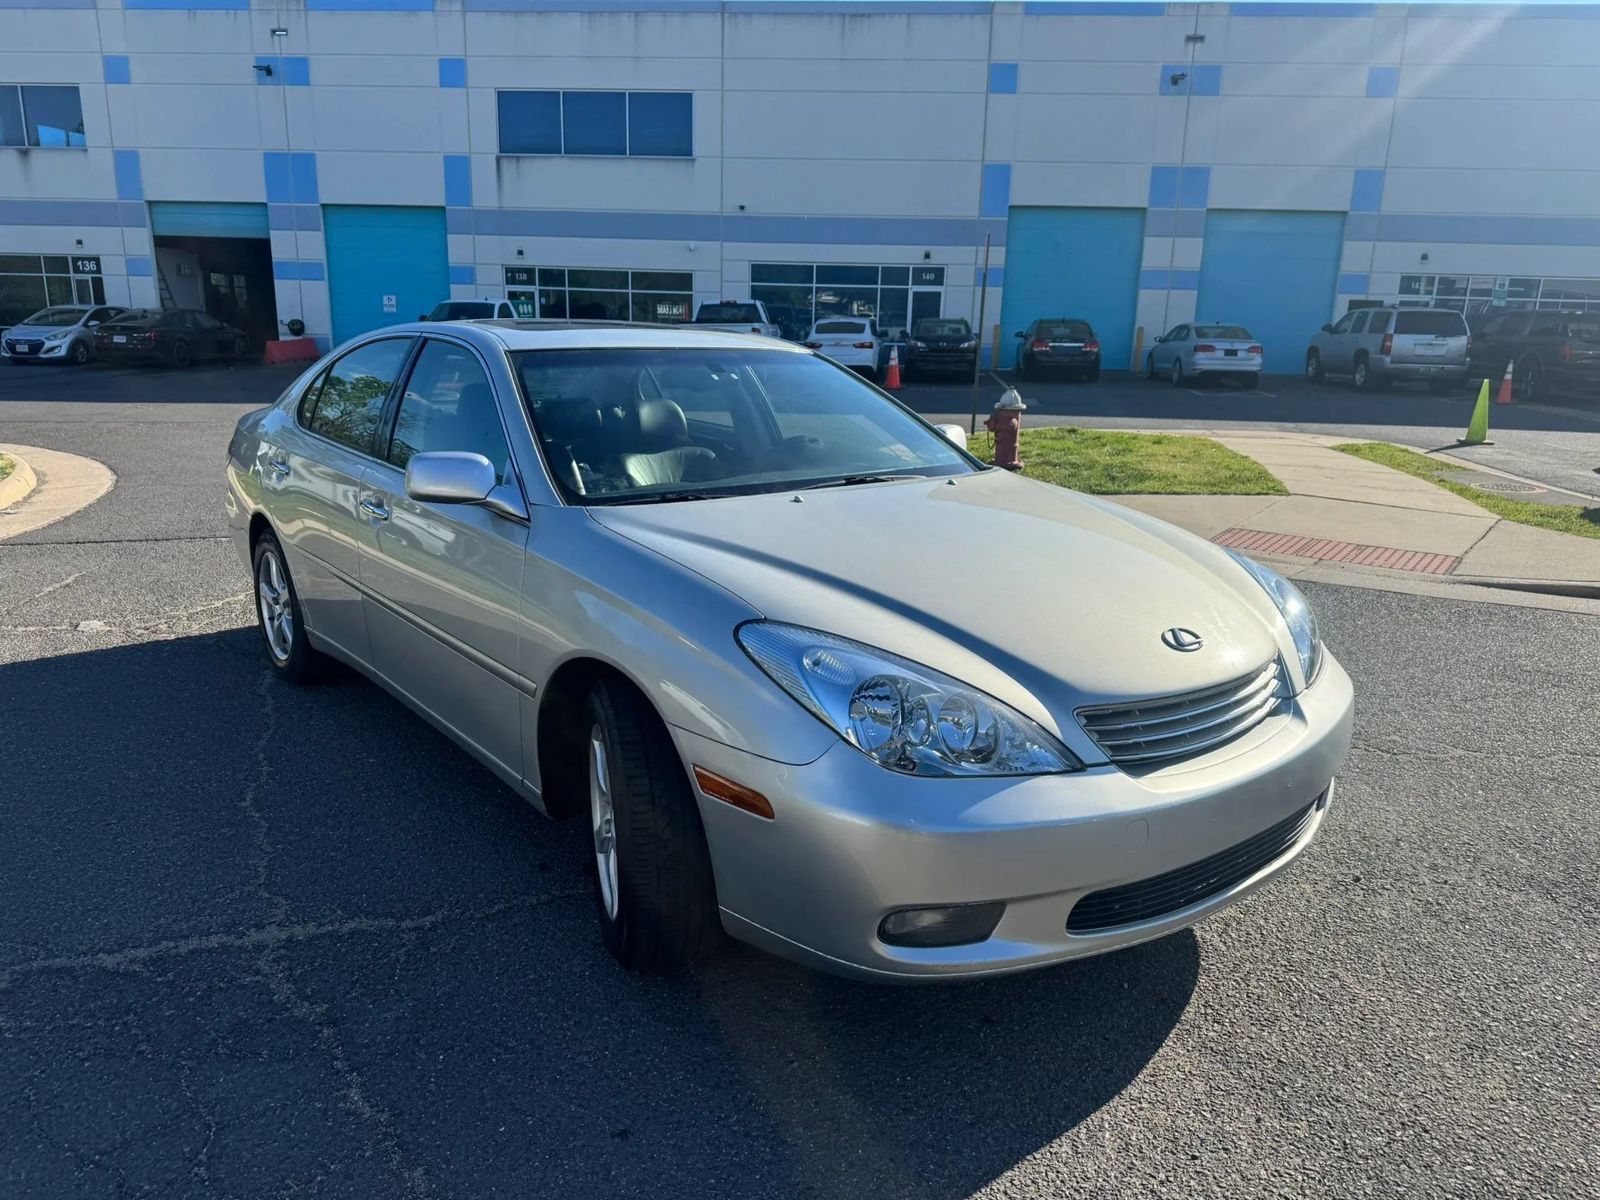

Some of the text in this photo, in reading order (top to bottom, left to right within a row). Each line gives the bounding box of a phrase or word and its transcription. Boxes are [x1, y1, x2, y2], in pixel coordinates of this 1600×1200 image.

[77, 260, 97, 271] 136
[515, 272, 528, 280] 138
[922, 272, 935, 281] 140
